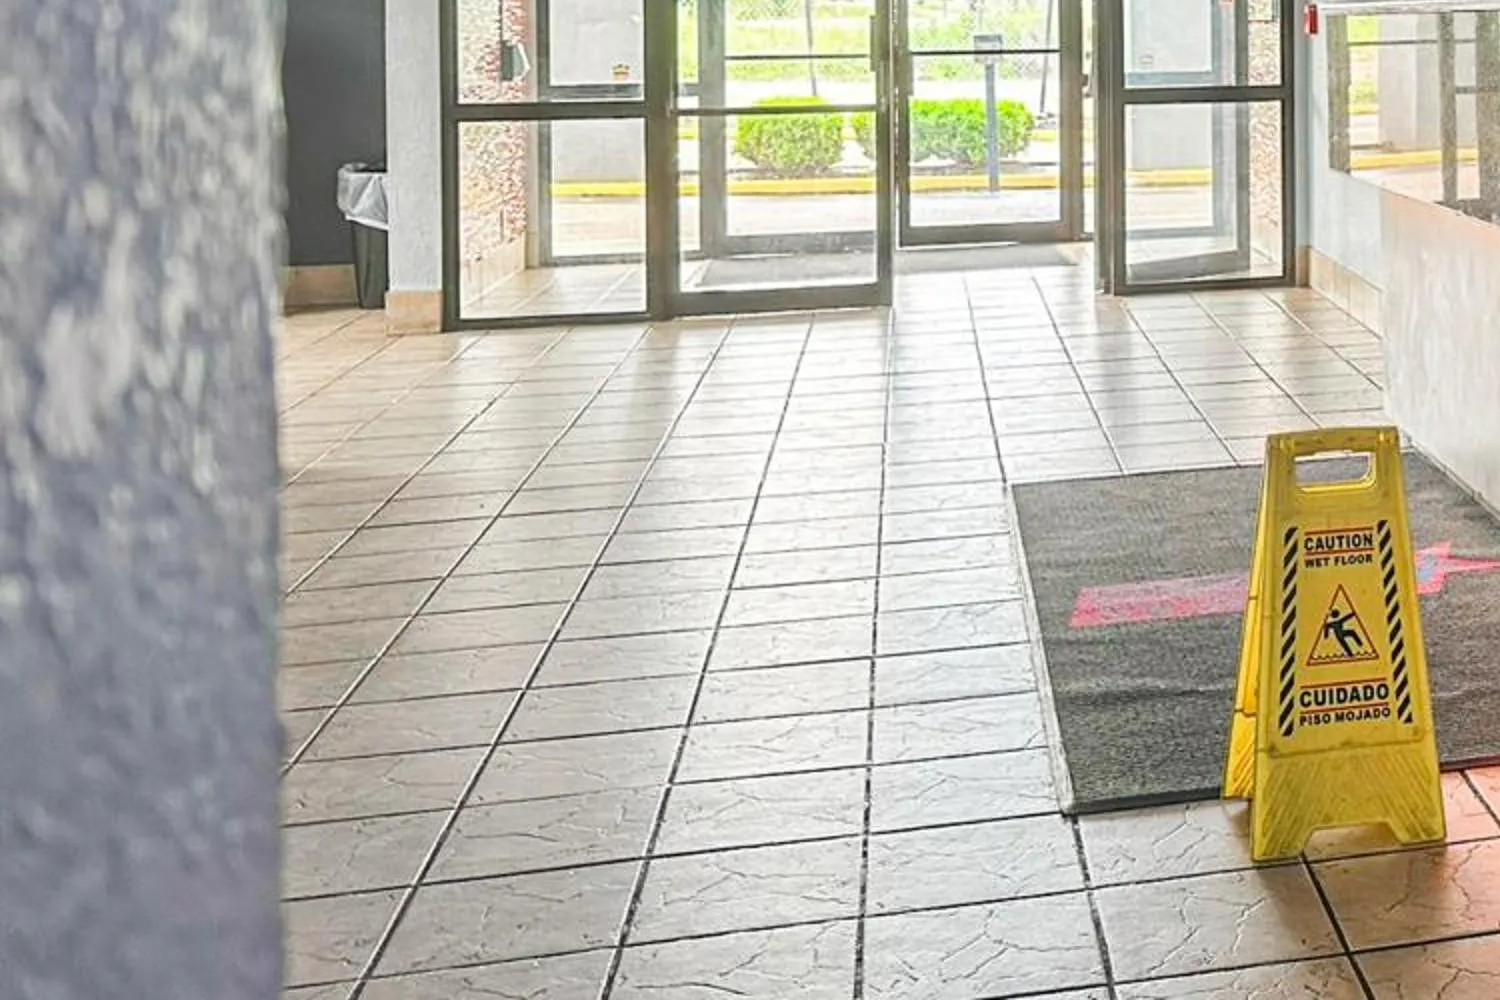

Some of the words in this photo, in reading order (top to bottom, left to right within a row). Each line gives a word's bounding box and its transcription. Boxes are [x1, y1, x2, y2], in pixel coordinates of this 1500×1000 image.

[1303, 533, 1374, 551] CAUTION
[1304, 556, 1330, 569] WET
[1334, 553, 1374, 567] FLOOR
[1299, 683, 1390, 708] CUIDADO
[1299, 713, 1331, 727] PISO
[1335, 707, 1391, 724] MOJADO
